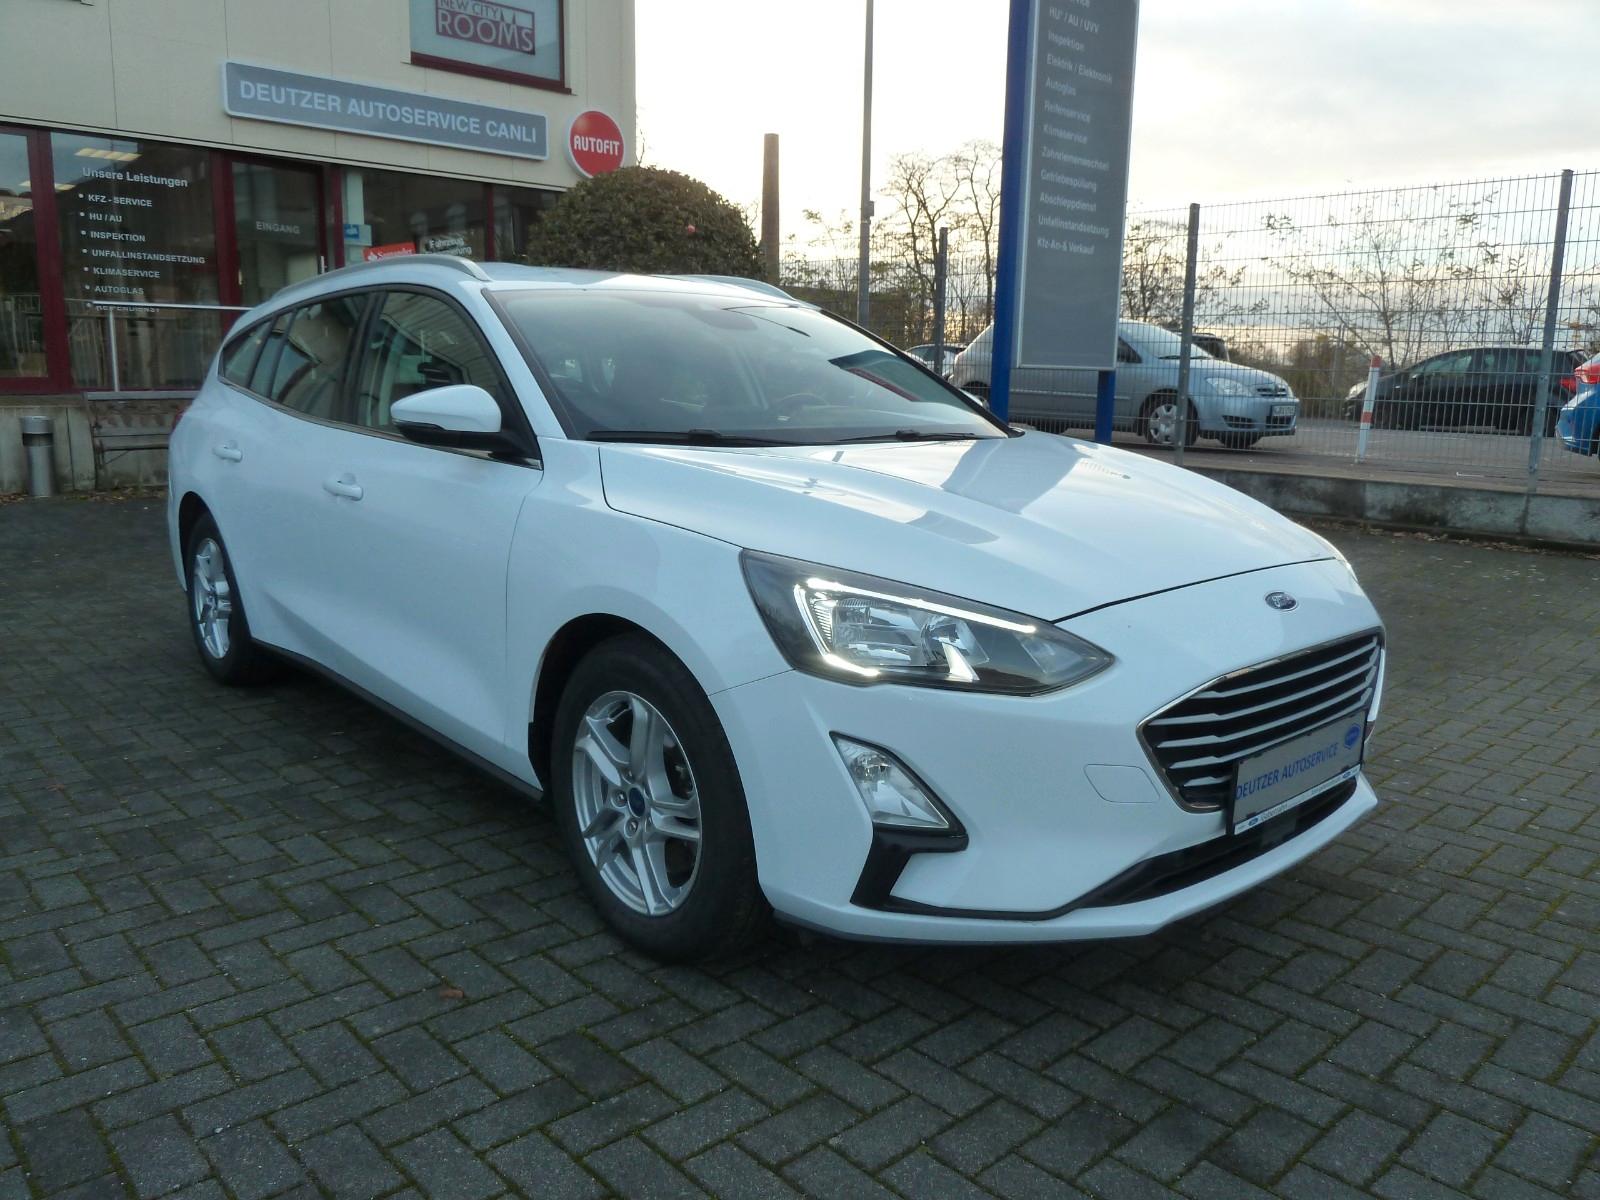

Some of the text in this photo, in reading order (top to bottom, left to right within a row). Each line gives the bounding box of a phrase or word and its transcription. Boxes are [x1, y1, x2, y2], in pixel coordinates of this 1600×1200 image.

[440, 0, 499, 17] NEW CITY
[438, 10, 534, 51] ROOMS
[240, 80, 536, 143] DEUTZER AUTOSERVICE CANLI
[574, 135, 620, 156] AUTOFIT
[82, 167, 188, 188] Unsere Leistungen
[88, 194, 107, 203] KFZ
[113, 196, 153, 207] SERVICE
[89, 212, 102, 221] HU
[109, 215, 122, 223] AU
[255, 221, 301, 235] EINGANG
[90, 230, 146, 242] INSPEKTION
[92, 249, 205, 264] UNFALLINSTANDSETZUNG
[93, 267, 160, 278] KLIMASERVICE
[94, 285, 144, 295] AUTOGLAS
[1236, 769, 1279, 800] DEUTZER
[1281, 742, 1339, 781] AUTOSERVICE
